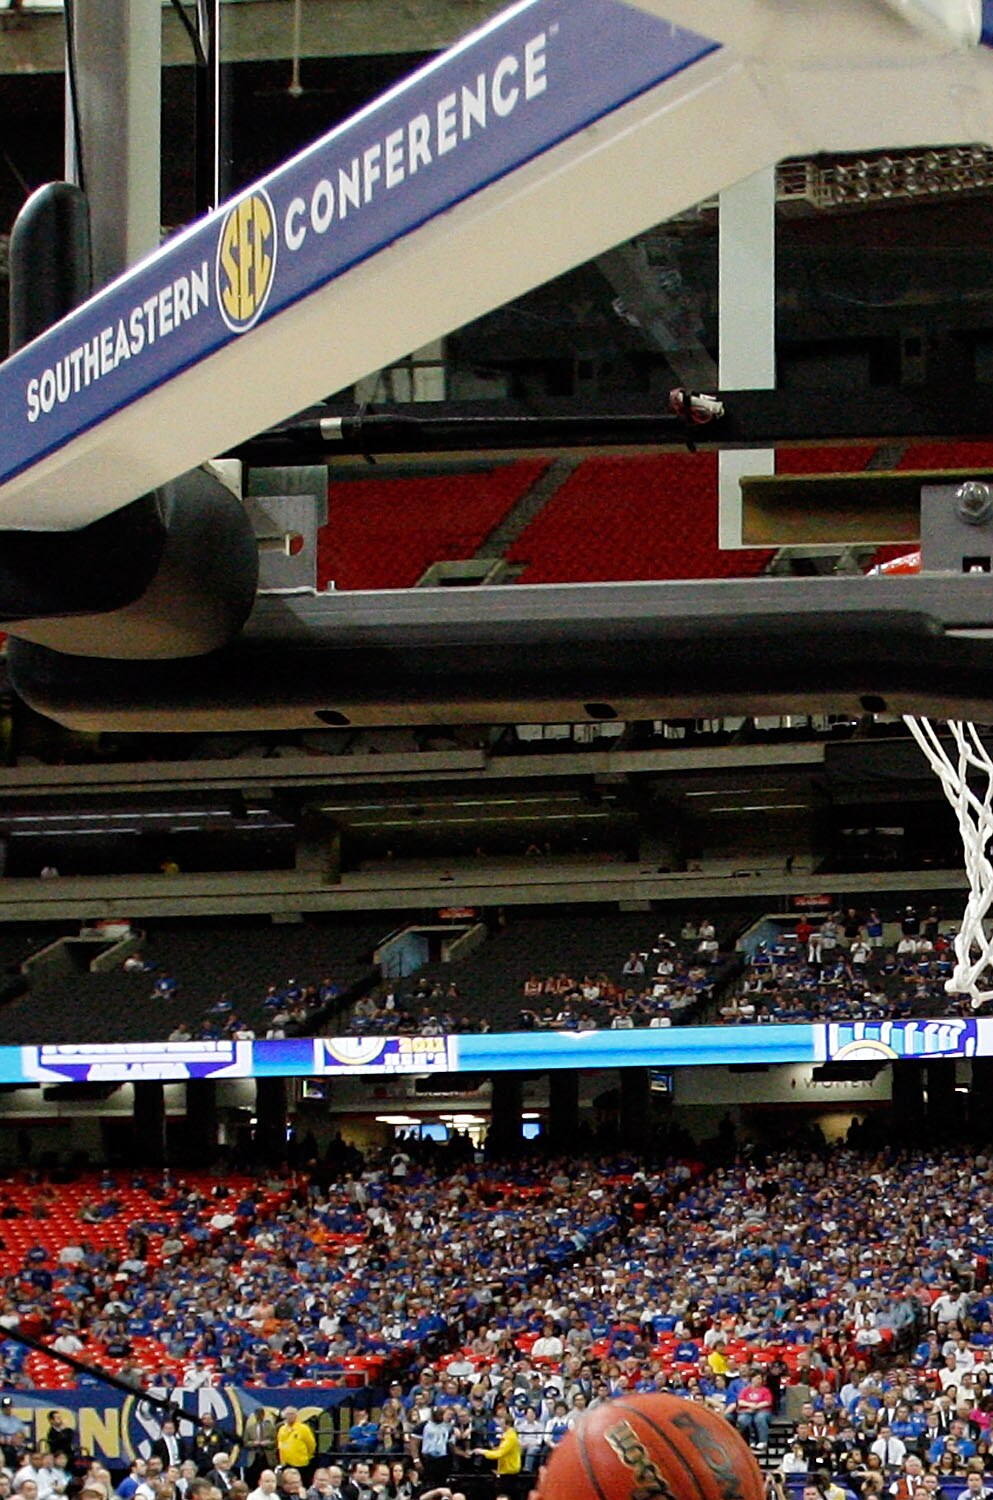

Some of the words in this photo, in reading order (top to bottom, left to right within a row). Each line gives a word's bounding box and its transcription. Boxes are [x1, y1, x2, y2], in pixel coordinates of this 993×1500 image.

[26, 261, 210, 424] SOUTHEASTERN
[221, 196, 271, 320] SEC
[285, 32, 548, 251] CONFERENCE
